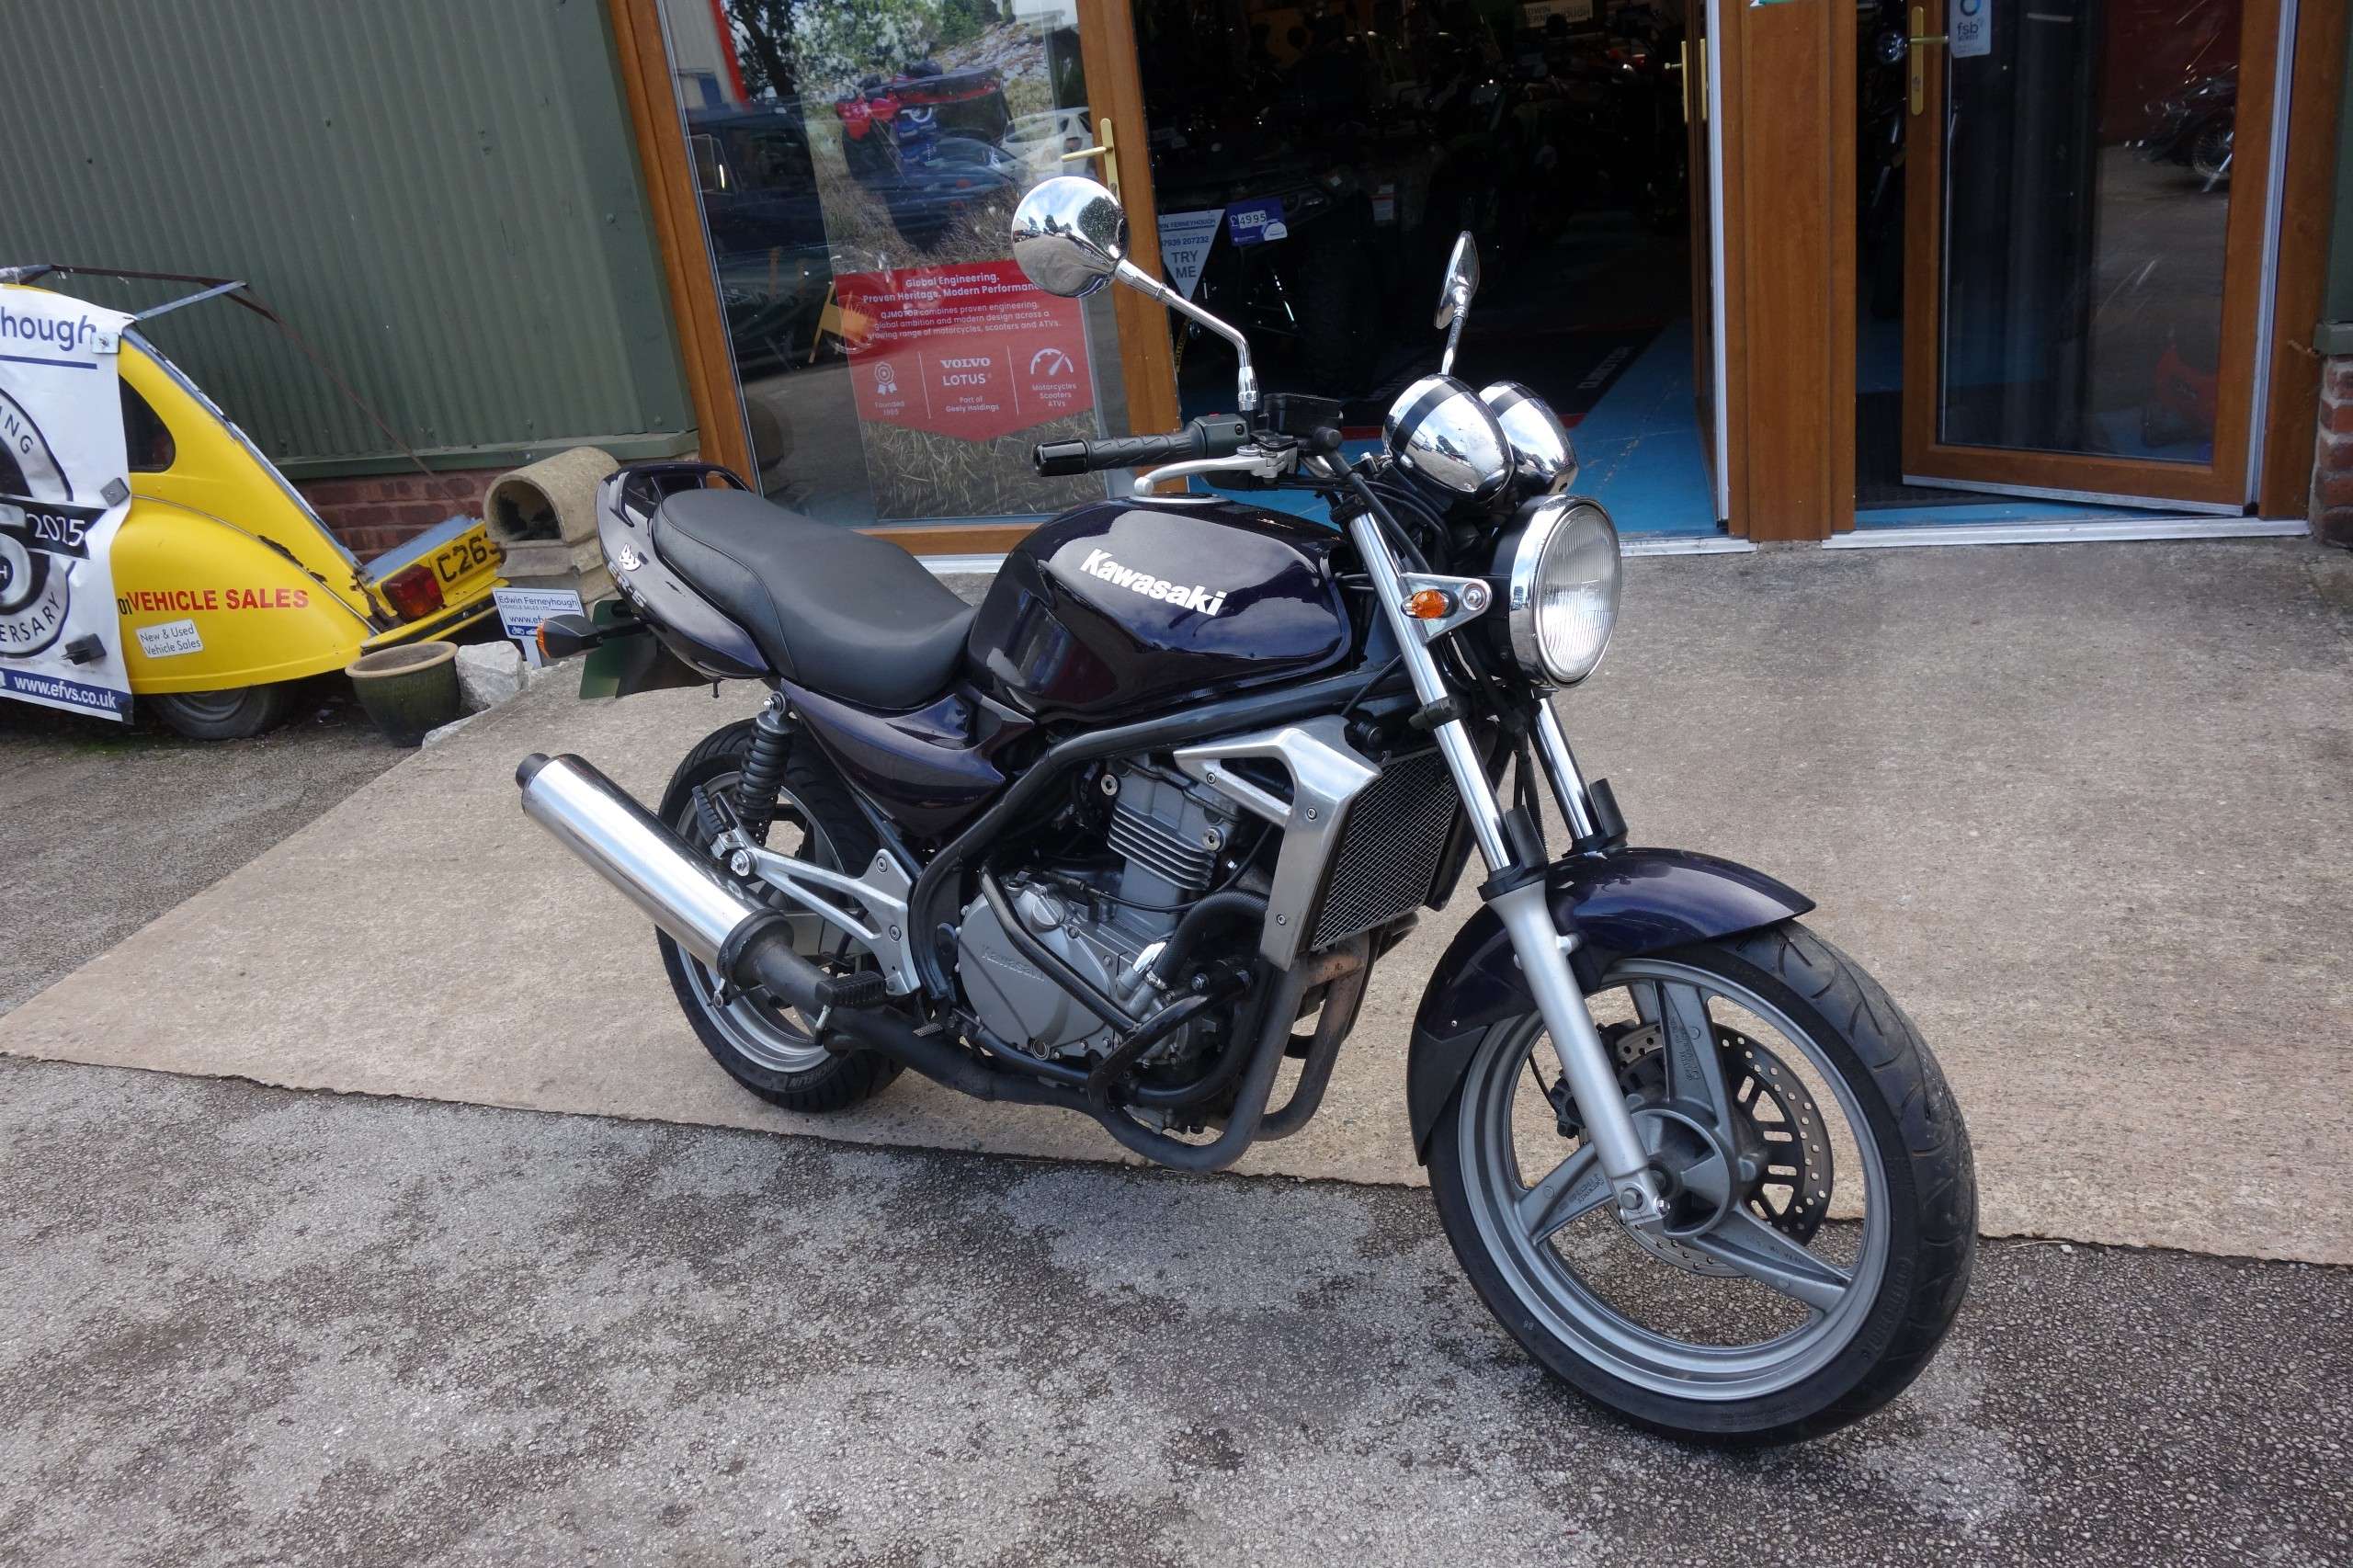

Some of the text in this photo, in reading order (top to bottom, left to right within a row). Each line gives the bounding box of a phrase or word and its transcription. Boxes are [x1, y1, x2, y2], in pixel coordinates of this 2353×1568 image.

[1957, 21, 1979, 35] fsb
[1171, 249, 1199, 264] TRY
[1176, 266, 1196, 278] ME
[905, 278, 937, 288] Global
[862, 294, 896, 303] Proven
[943, 287, 980, 297] Modern
[920, 306, 958, 315] combines
[960, 304, 987, 314] proven
[874, 322, 898, 331] global
[900, 319, 936, 328] ambition
[936, 316, 952, 324] and
[953, 314, 984, 324] modern
[986, 312, 1013, 322] design
[1015, 311, 1042, 319] across
[867, 331, 898, 340] growing
[899, 329, 921, 338] range
[984, 323, 1019, 332] scooters
[1020, 321, 1037, 329] and
[940, 358, 991, 369] VOLVO
[942, 373, 986, 386] LOTUS
[1031, 382, 1077, 392] Motorcycles
[1039, 392, 1072, 400] Scooters
[1079, 548, 1228, 617] Kawasaki
[126, 589, 219, 612] VEHICLE
[225, 588, 310, 610] SALES
[498, 596, 577, 608] Edwin Ferneyhough
[140, 623, 194, 642] New & Used
[144, 639, 201, 655] Vehicle Sales
[14, 676, 117, 710] www.efvs.co.uk
